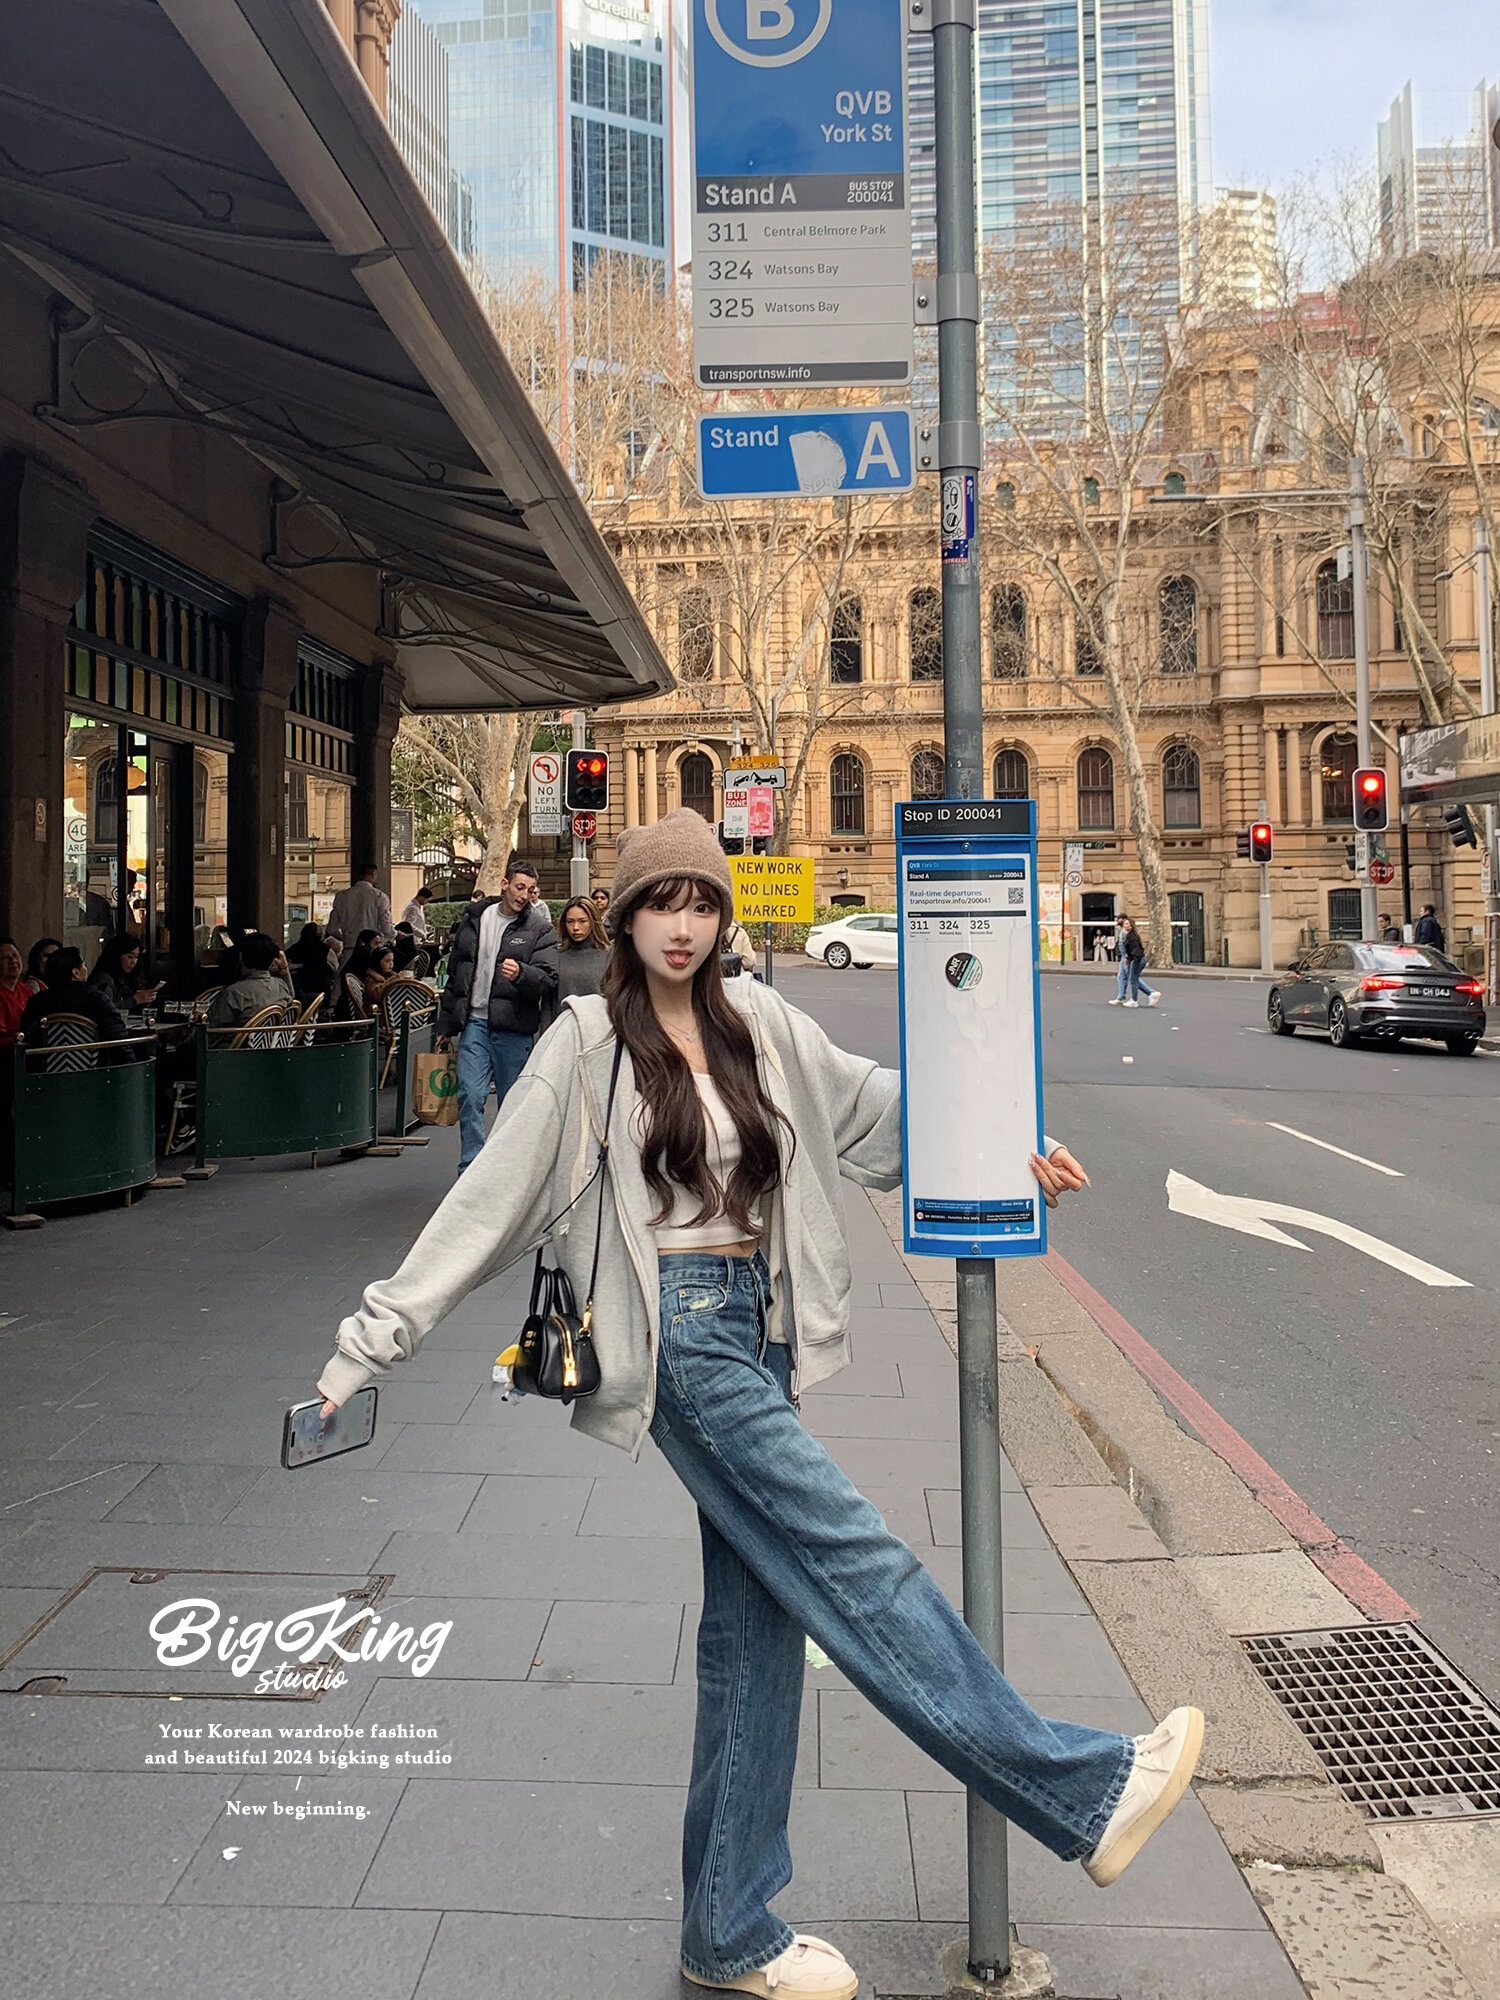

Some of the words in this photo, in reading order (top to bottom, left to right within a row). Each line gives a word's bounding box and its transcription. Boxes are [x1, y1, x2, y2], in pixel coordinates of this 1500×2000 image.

[746, 0, 795, 40] B
[835, 91, 892, 118] QVB
[820, 124, 867, 143] York
[871, 123, 892, 142] St
[849, 182, 868, 191] BUS
[869, 181, 894, 191] STOP
[705, 184, 774, 206] Stand
[780, 183, 797, 204] A
[847, 191, 894, 203] 200041
[707, 222, 748, 243] 311
[763, 226, 806, 237] Central
[809, 225, 858, 236] Belmore
[860, 224, 886, 235] Park
[708, 260, 753, 280] 324
[764, 263, 815, 276] Watsons
[817, 262, 839, 277] Bay
[708, 297, 755, 318] 325
[765, 301, 815, 313] Watsons
[818, 301, 840, 315] Bay
[708, 367, 811, 383] transportnsw.info
[710, 425, 779, 449] Stand
[855, 421, 901, 480] A
[537, 787, 554, 796] NO
[726, 799, 747, 807] ZONE
[904, 809, 933, 823] Stop
[937, 809, 950, 820] ID
[955, 808, 1002, 820] 200041
[574, 819, 596, 830] STOP
[736, 860, 764, 874] NEW
[766, 861, 803, 875] WORK
[1370, 866, 1394, 878] STOP
[1069, 874, 1080, 884] 30
[740, 883, 759, 896] NO
[762, 883, 799, 896] LINES
[943, 889, 983, 898] departures
[909, 897, 992, 905] transportnsw.info/200041
[742, 904, 796, 918] MARKED
[909, 920, 929, 930] 311
[939, 920, 959, 930] 324
[969, 919, 991, 930] 325
